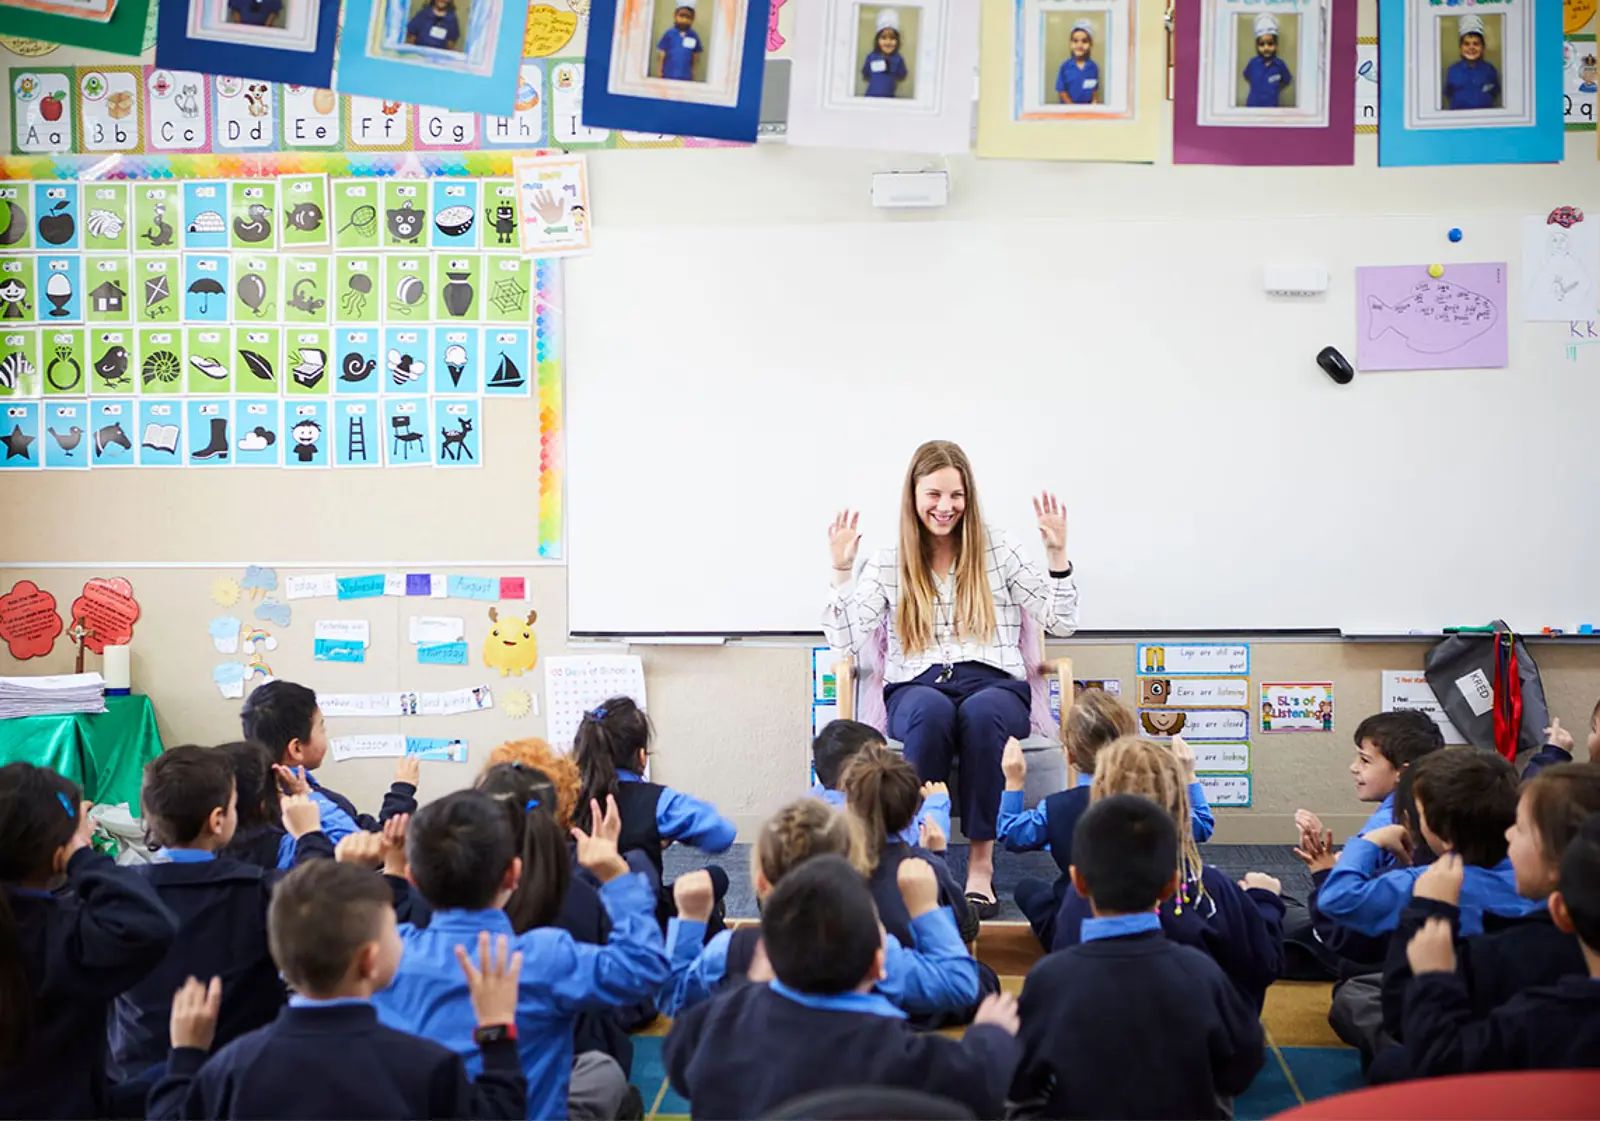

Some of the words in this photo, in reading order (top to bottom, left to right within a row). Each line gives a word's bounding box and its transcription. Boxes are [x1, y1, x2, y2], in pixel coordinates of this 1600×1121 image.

[456, 576, 493, 600] August
[1177, 685, 1195, 697] Ears
[1200, 689, 1212, 697] are
[1471, 672, 1490, 700] KRED
[1302, 696, 1317, 706] of
[1205, 721, 1217, 729] are
[1204, 753, 1217, 761] are
[1222, 750, 1246, 765] looking
